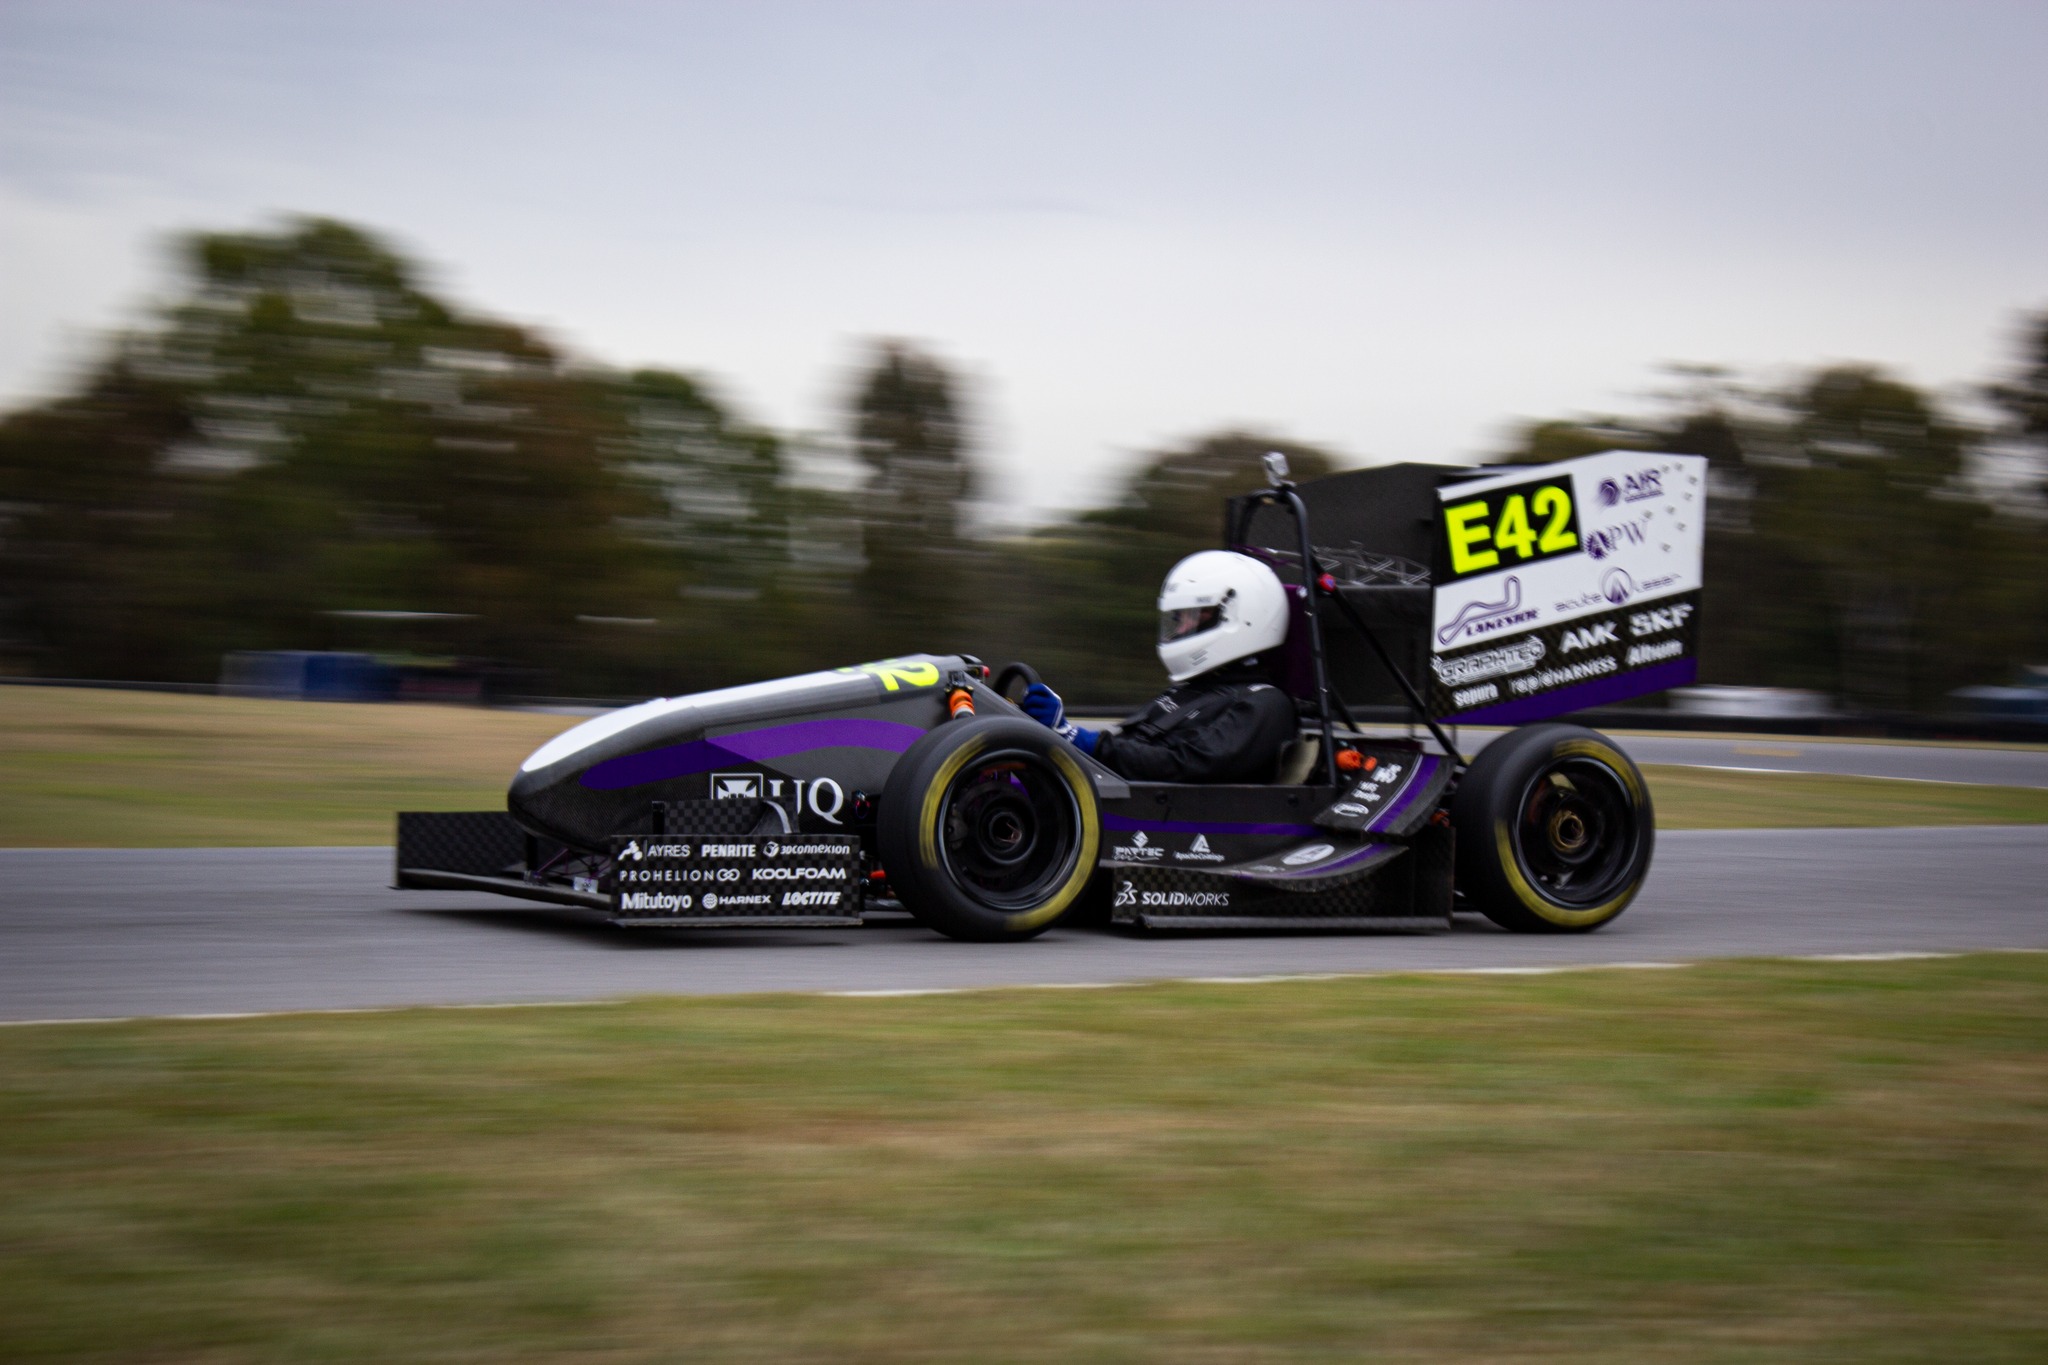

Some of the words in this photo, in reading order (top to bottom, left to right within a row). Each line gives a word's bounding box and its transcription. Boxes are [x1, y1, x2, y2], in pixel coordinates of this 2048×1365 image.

[1444, 486, 1578, 574] E42
[1628, 602, 1693, 637] SKF
[1558, 621, 1620, 654] AMK
[647, 843, 691, 858] AYRES
[701, 843, 756, 858] PENRITE
[619, 869, 715, 882] PROHELION
[752, 867, 847, 880] KOOLFOAM
[621, 892, 693, 912] Mitutoyo
[719, 895, 771, 905] HARNEX
[781, 891, 842, 906] LOCTITE
[1141, 891, 1230, 907] SOLIDWORKS
